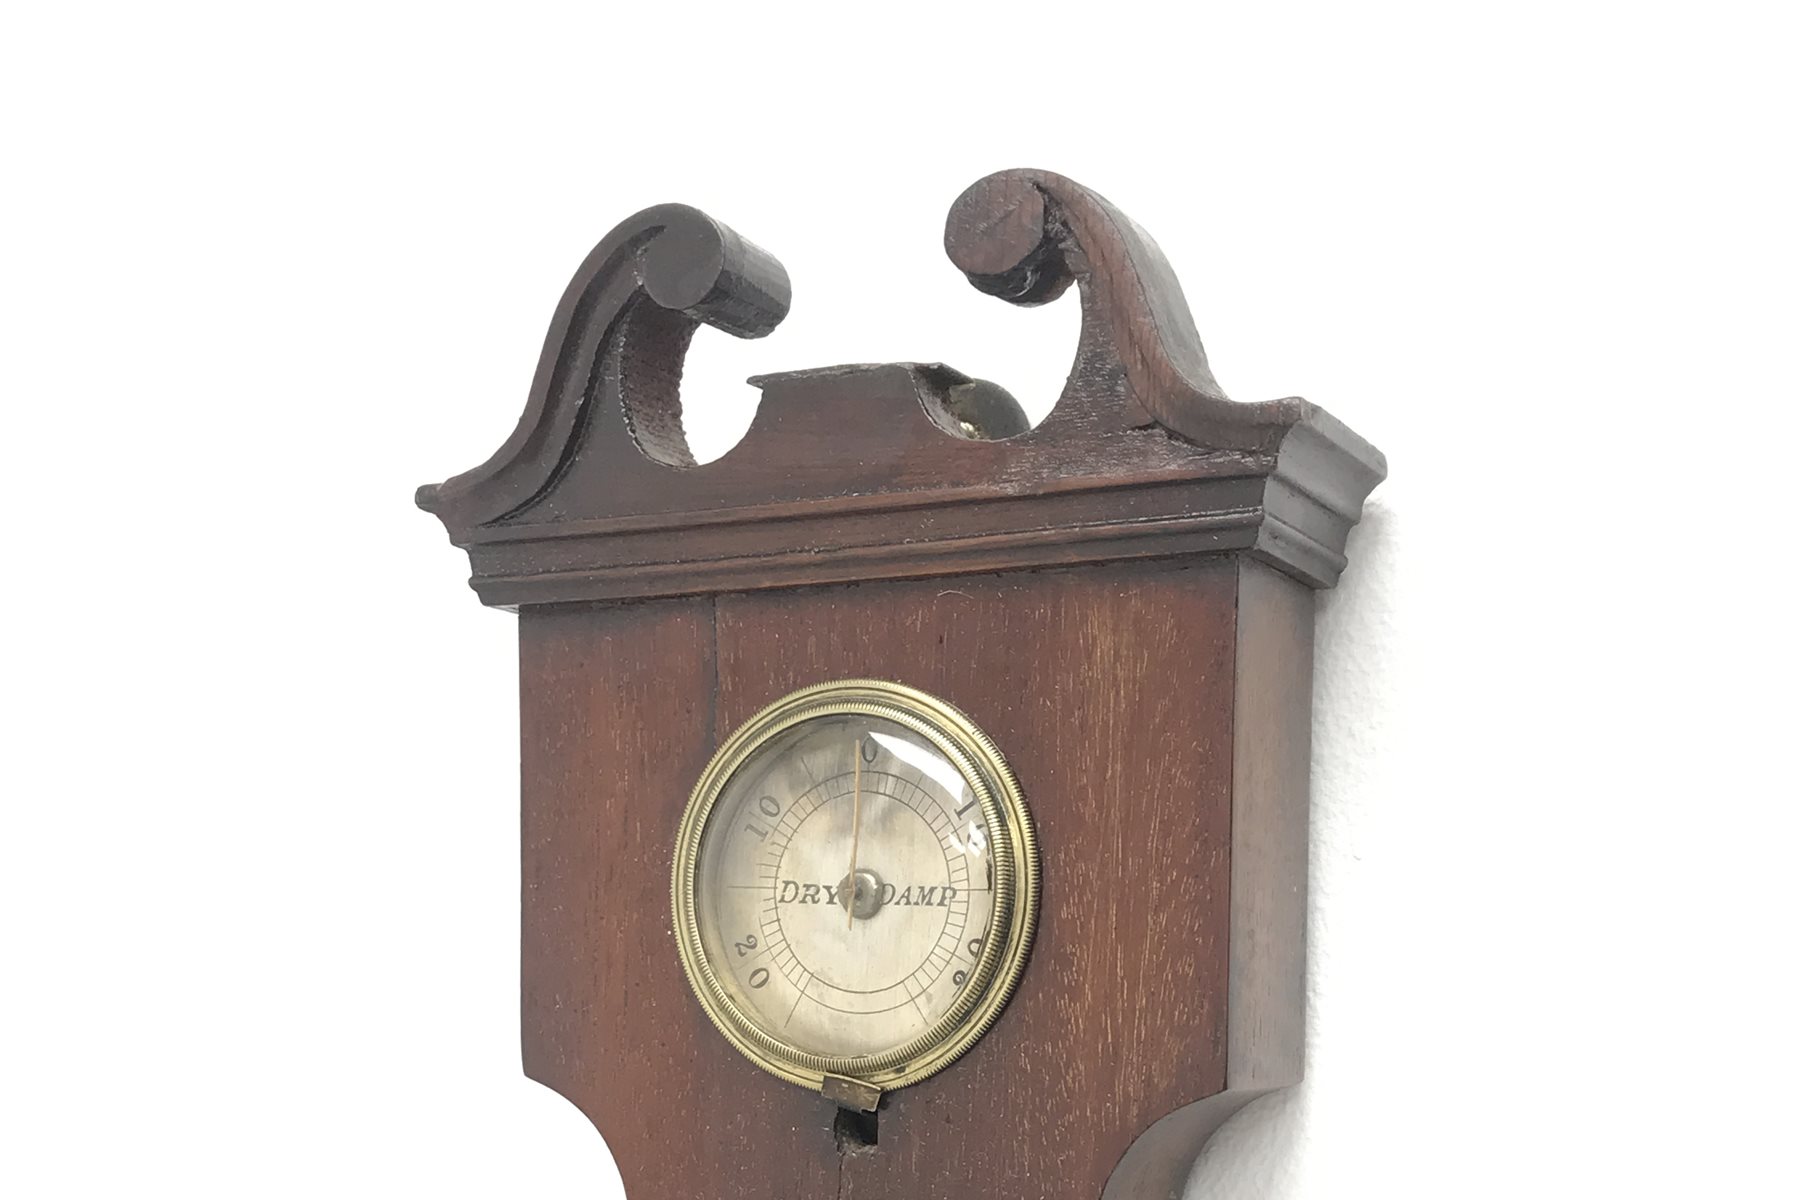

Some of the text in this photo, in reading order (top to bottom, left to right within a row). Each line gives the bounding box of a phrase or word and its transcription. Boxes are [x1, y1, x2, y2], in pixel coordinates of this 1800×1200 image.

[861, 737, 878, 765] 0
[744, 795, 781, 843] 10
[778, 880, 838, 905] DRY
[881, 883, 957, 907] DAMP
[734, 934, 770, 990] 20
